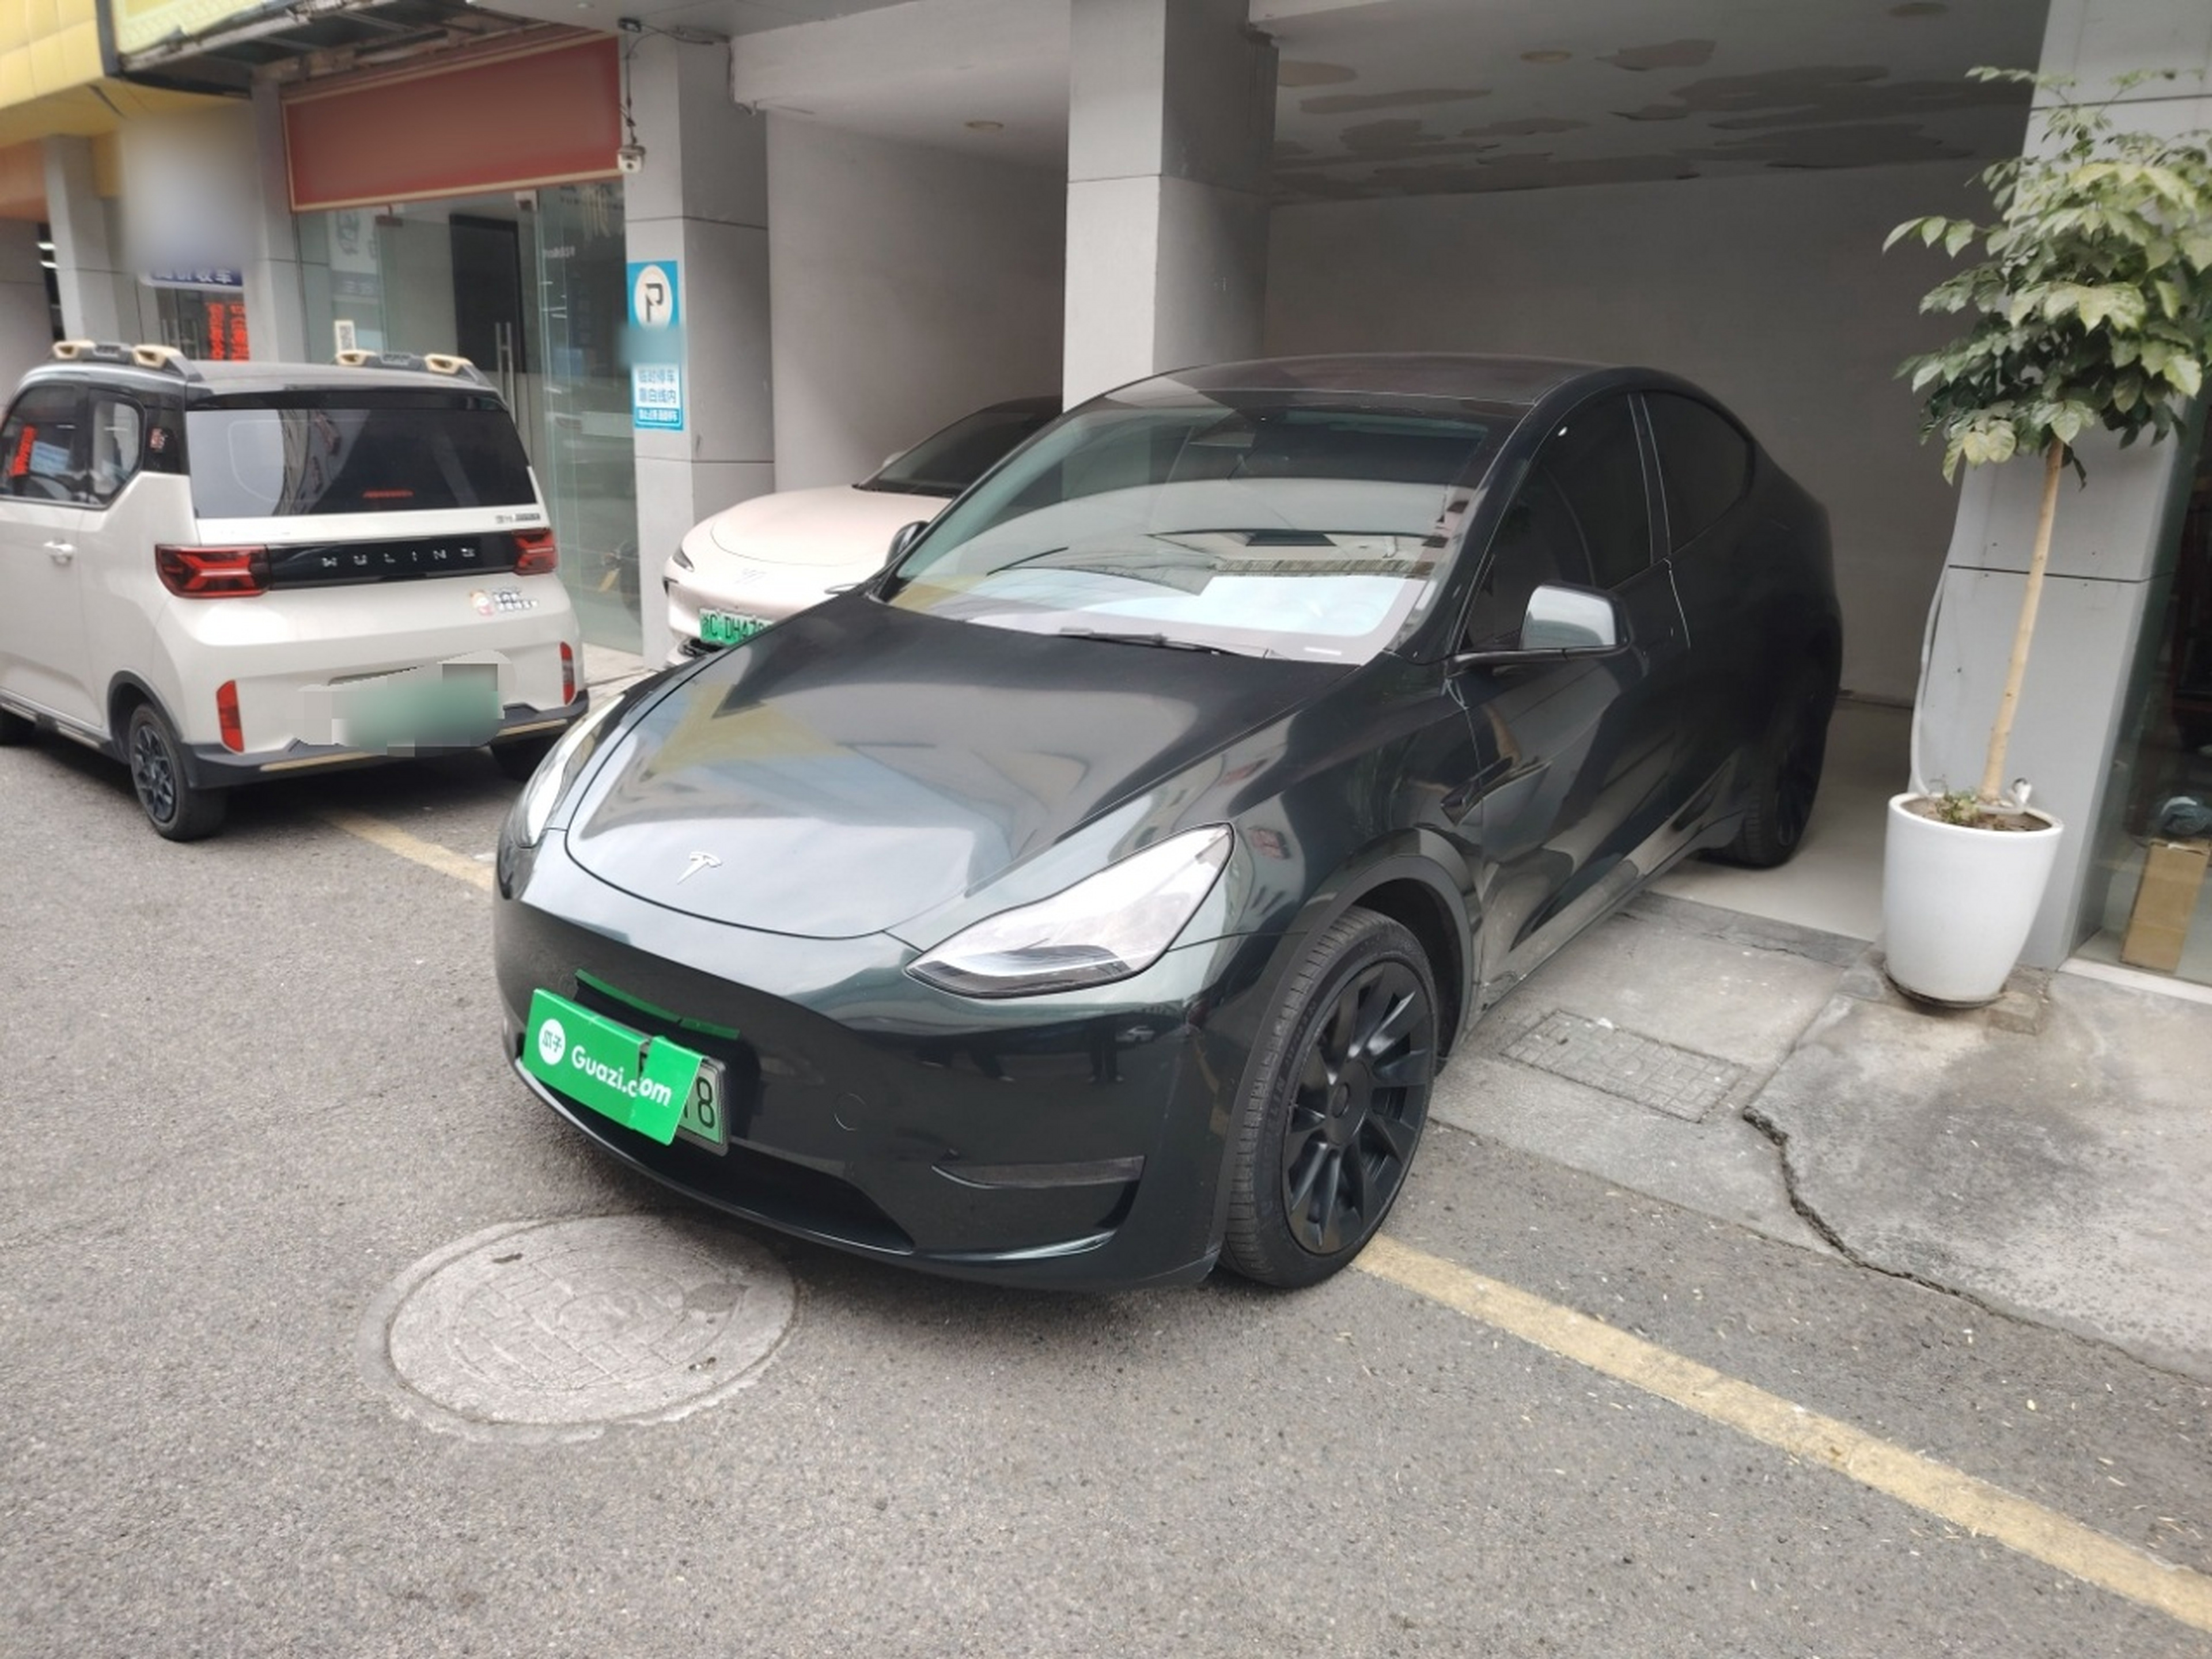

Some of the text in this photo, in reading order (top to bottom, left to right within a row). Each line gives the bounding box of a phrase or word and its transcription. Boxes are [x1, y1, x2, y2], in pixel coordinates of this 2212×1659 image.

[645, 283, 664, 322] P
[321, 548, 476, 567] WULING
[571, 1045, 672, 1108] Guazi.com
